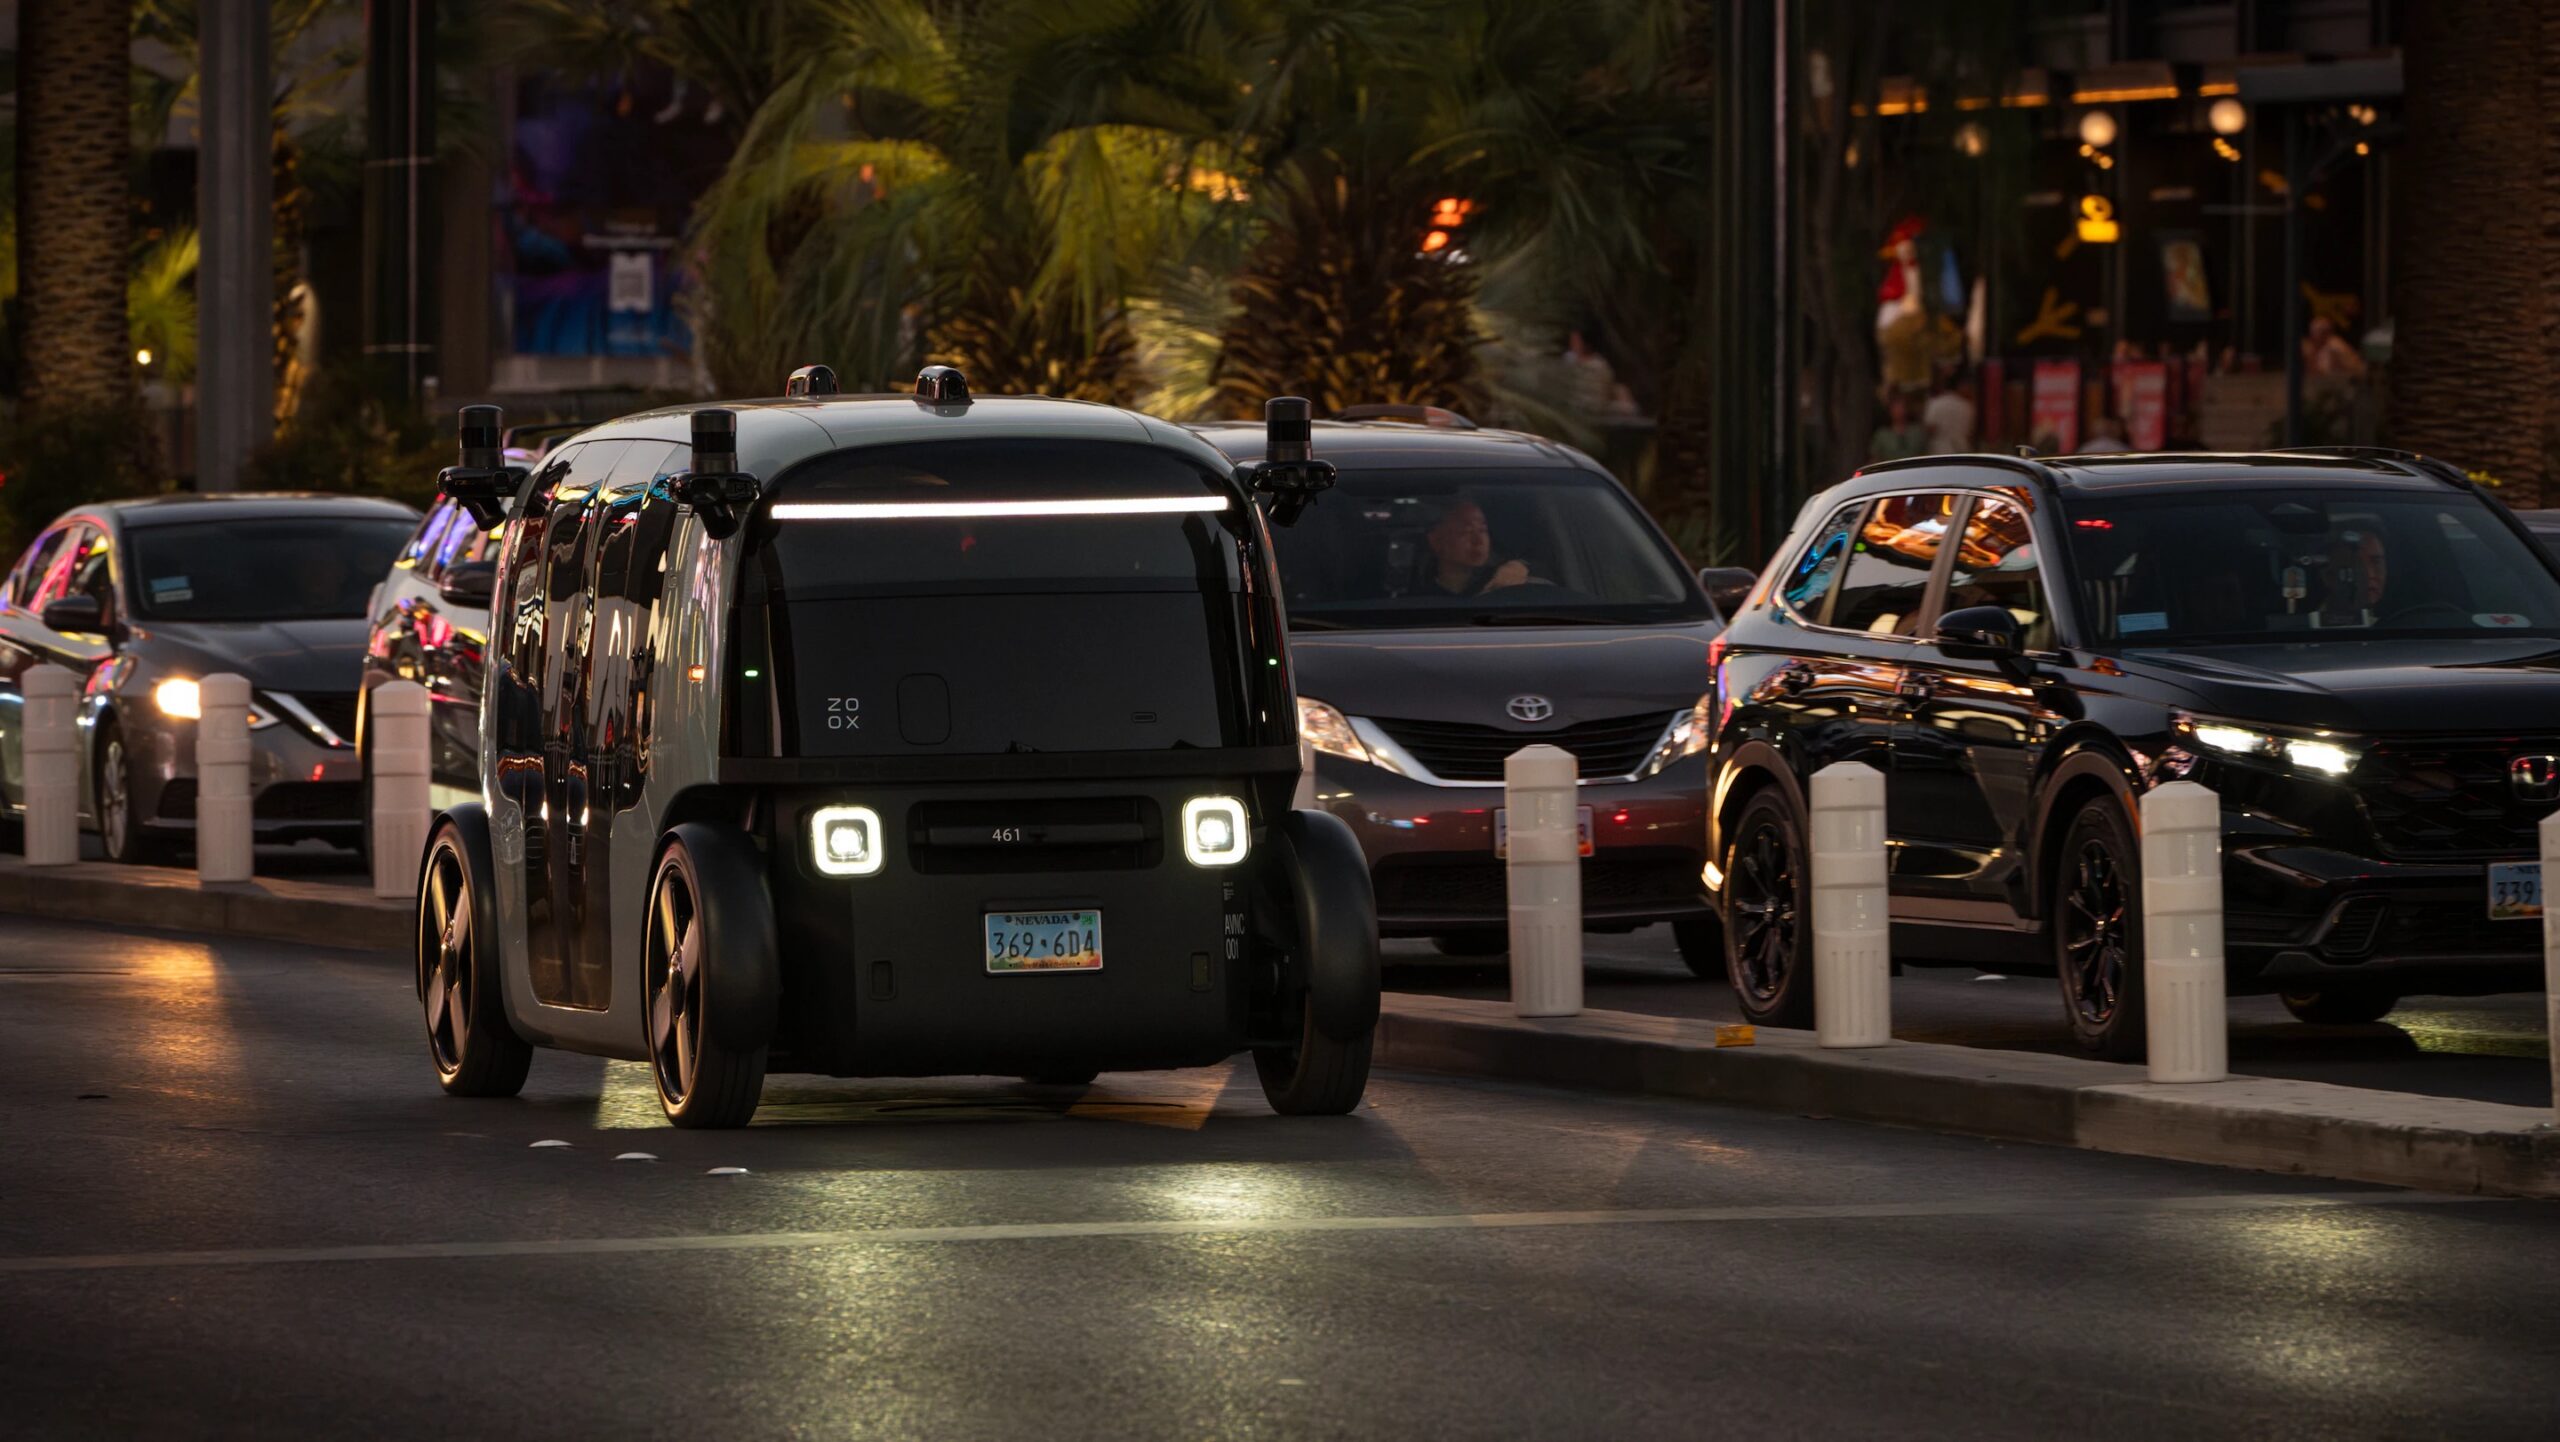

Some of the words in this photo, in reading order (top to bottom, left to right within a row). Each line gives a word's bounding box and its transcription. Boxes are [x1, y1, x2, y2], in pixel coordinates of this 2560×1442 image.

[827, 697, 860, 711] ZO
[827, 715, 860, 729] OX
[992, 828, 1021, 842] 461
[1015, 915, 1070, 926] NEVADA
[1225, 937, 1240, 960] 001
